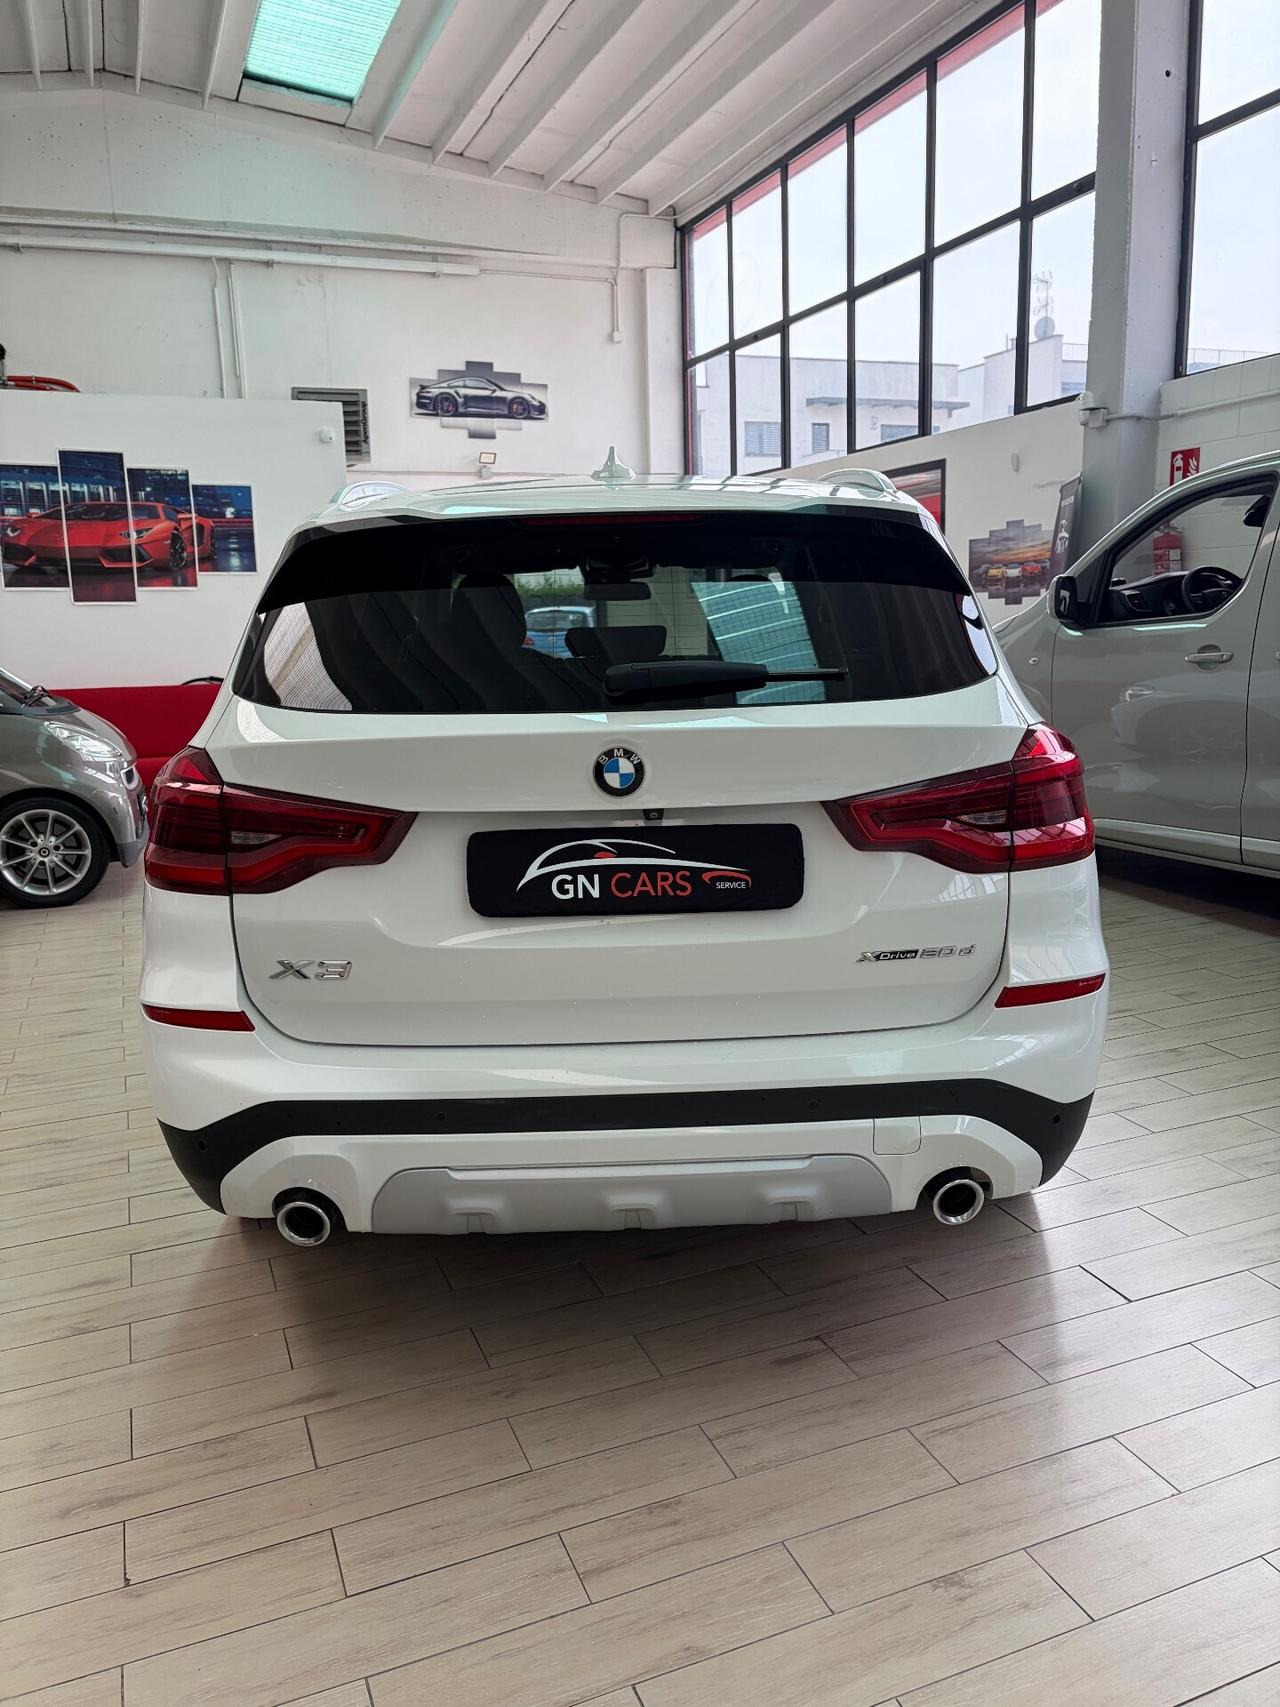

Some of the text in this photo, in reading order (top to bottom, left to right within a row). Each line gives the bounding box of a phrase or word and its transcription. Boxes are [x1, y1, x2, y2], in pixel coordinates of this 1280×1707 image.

[598, 748, 641, 765] BMW
[551, 870, 747, 899] GN CARS SERVICE
[268, 959, 353, 980] X3
